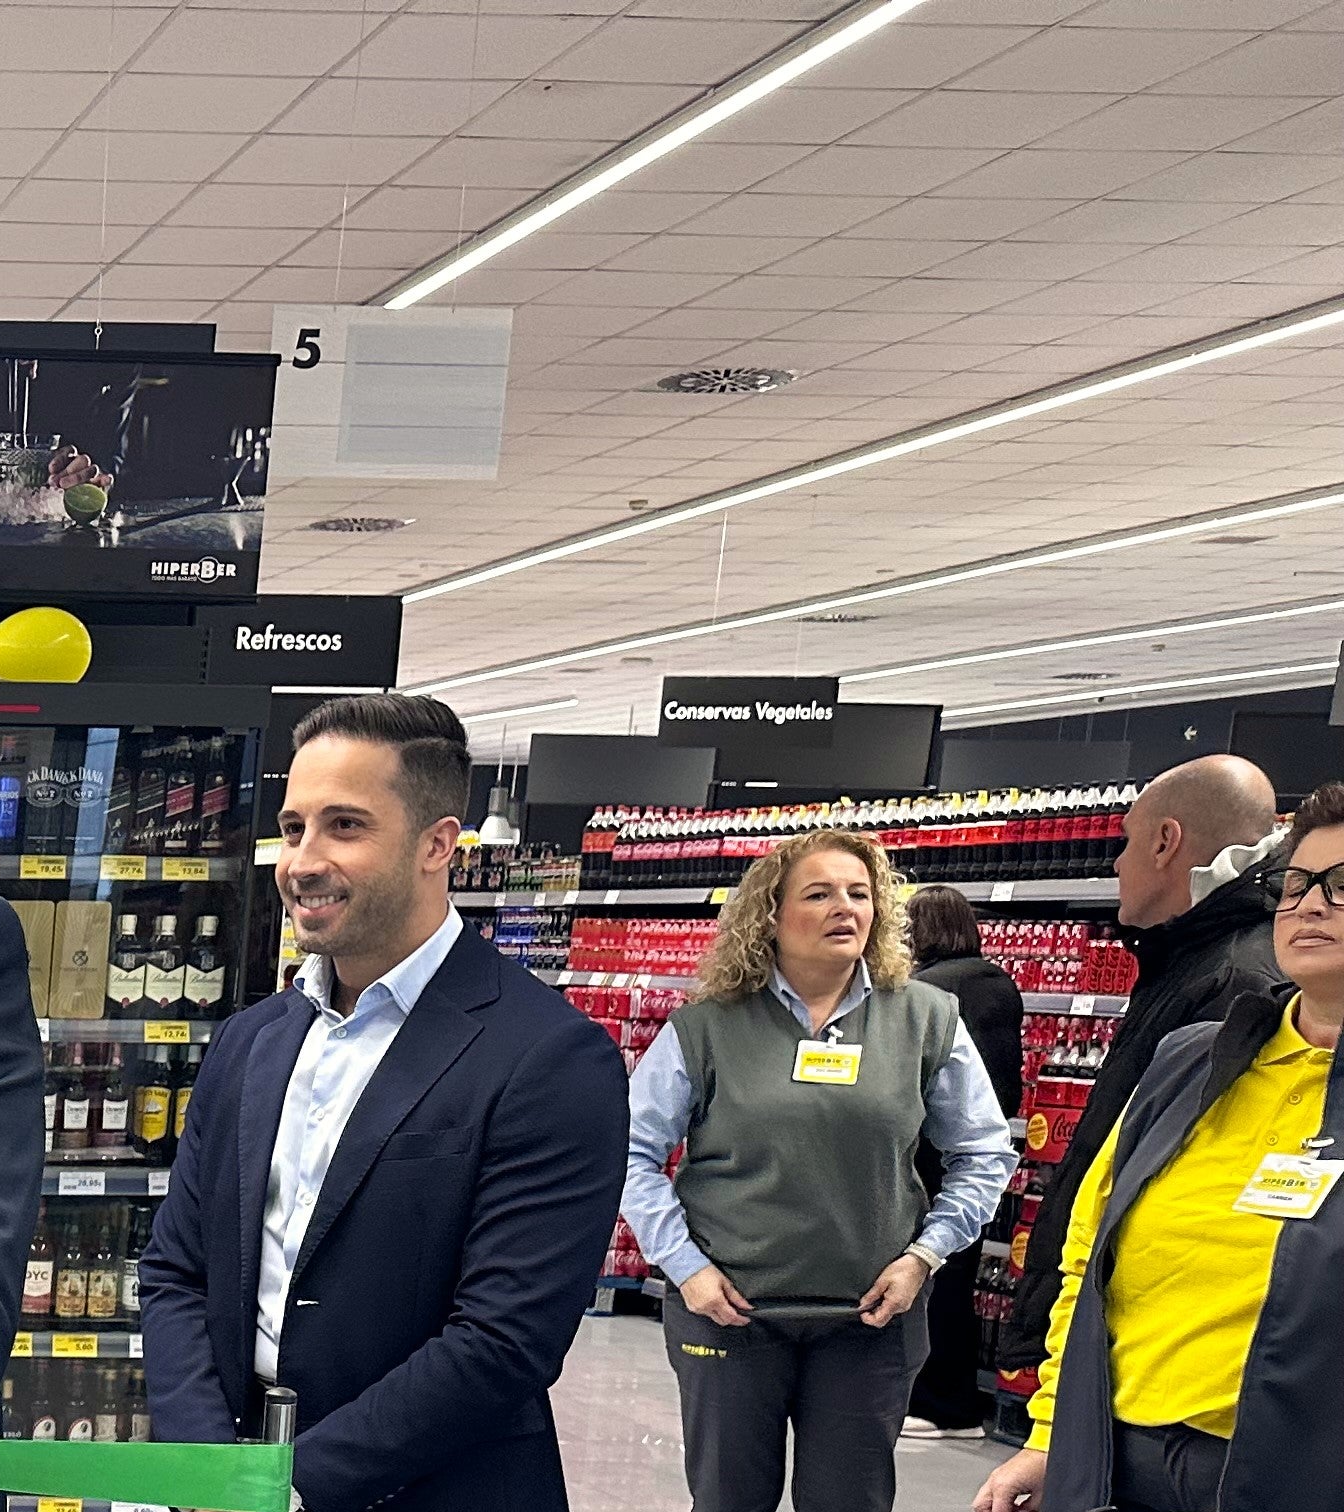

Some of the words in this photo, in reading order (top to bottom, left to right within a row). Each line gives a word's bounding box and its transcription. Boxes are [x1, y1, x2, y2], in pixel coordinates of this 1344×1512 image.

[291, 329, 323, 369] 5
[151, 560, 237, 579] HIPERBER
[236, 624, 343, 655] Refrescos
[664, 701, 751, 720] Conservas
[755, 700, 834, 725] Vegetales
